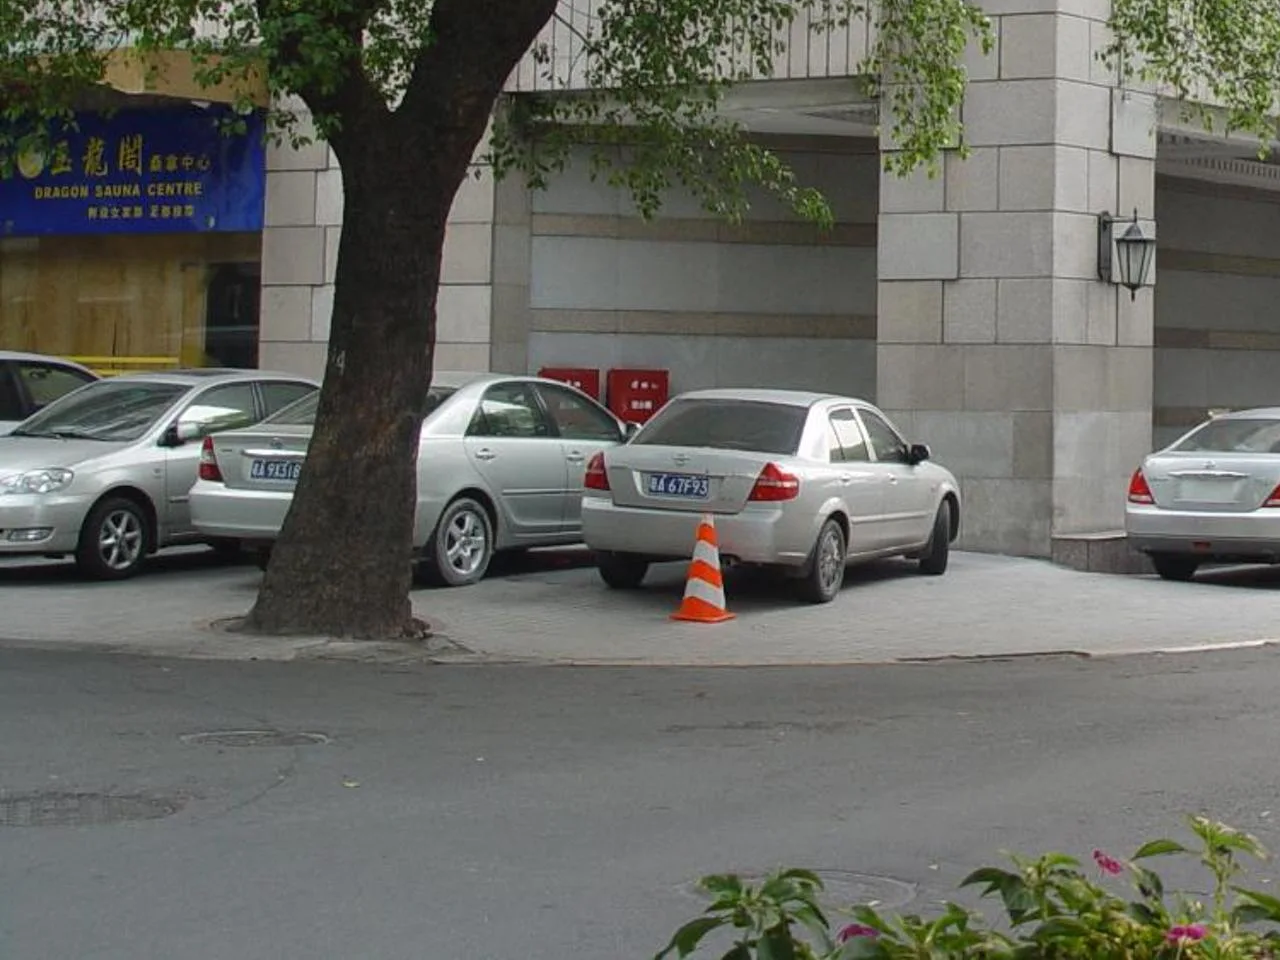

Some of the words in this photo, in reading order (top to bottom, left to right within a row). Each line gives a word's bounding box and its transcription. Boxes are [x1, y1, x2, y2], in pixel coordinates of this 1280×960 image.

[35, 186, 89, 200] DRAGON
[95, 184, 140, 198] SAUNA
[147, 182, 203, 196] CENTRE
